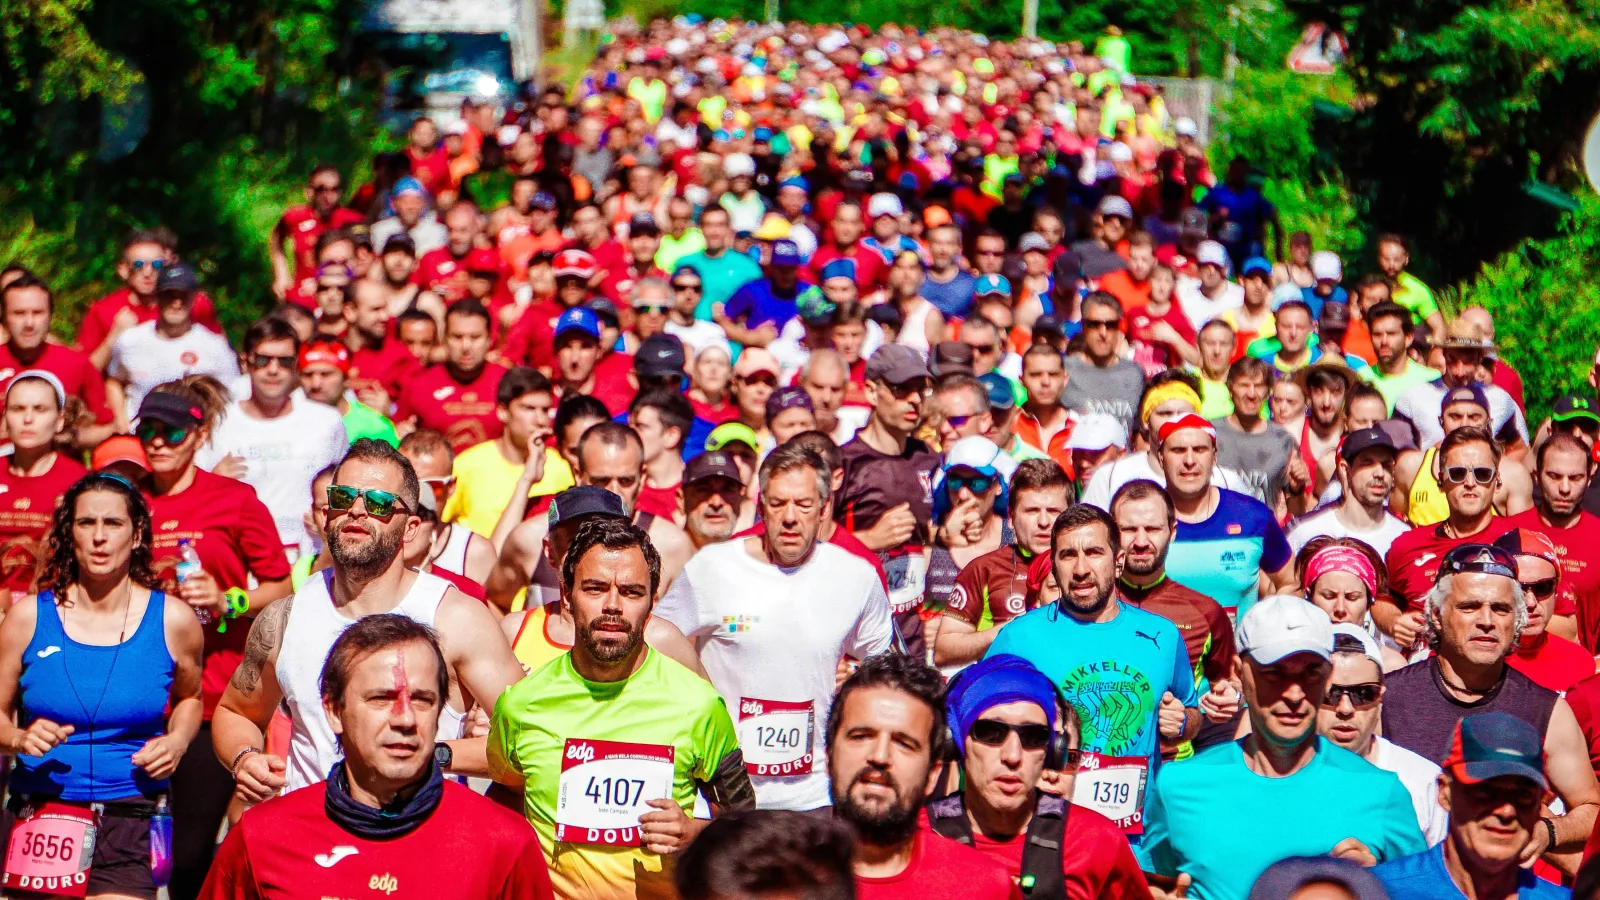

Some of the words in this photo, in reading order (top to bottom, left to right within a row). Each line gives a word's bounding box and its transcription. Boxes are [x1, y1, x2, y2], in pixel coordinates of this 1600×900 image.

[1087, 399, 1133, 417] SANTA
[891, 594, 924, 613] DOURO
[1062, 661, 1150, 693] MIKKELLER
[742, 701, 764, 717] edp
[757, 726, 800, 748] 1240
[1082, 742, 1102, 753] ER
[1111, 726, 1145, 757] MILE
[566, 742, 595, 764] edp
[758, 753, 812, 774] DOURO
[585, 776, 645, 807] 4107
[1093, 781, 1130, 804] 1319
[587, 826, 643, 842] DOU
[22, 832, 74, 861] 3656
[20, 871, 86, 889] DOURO
[368, 872, 398, 896] edp
